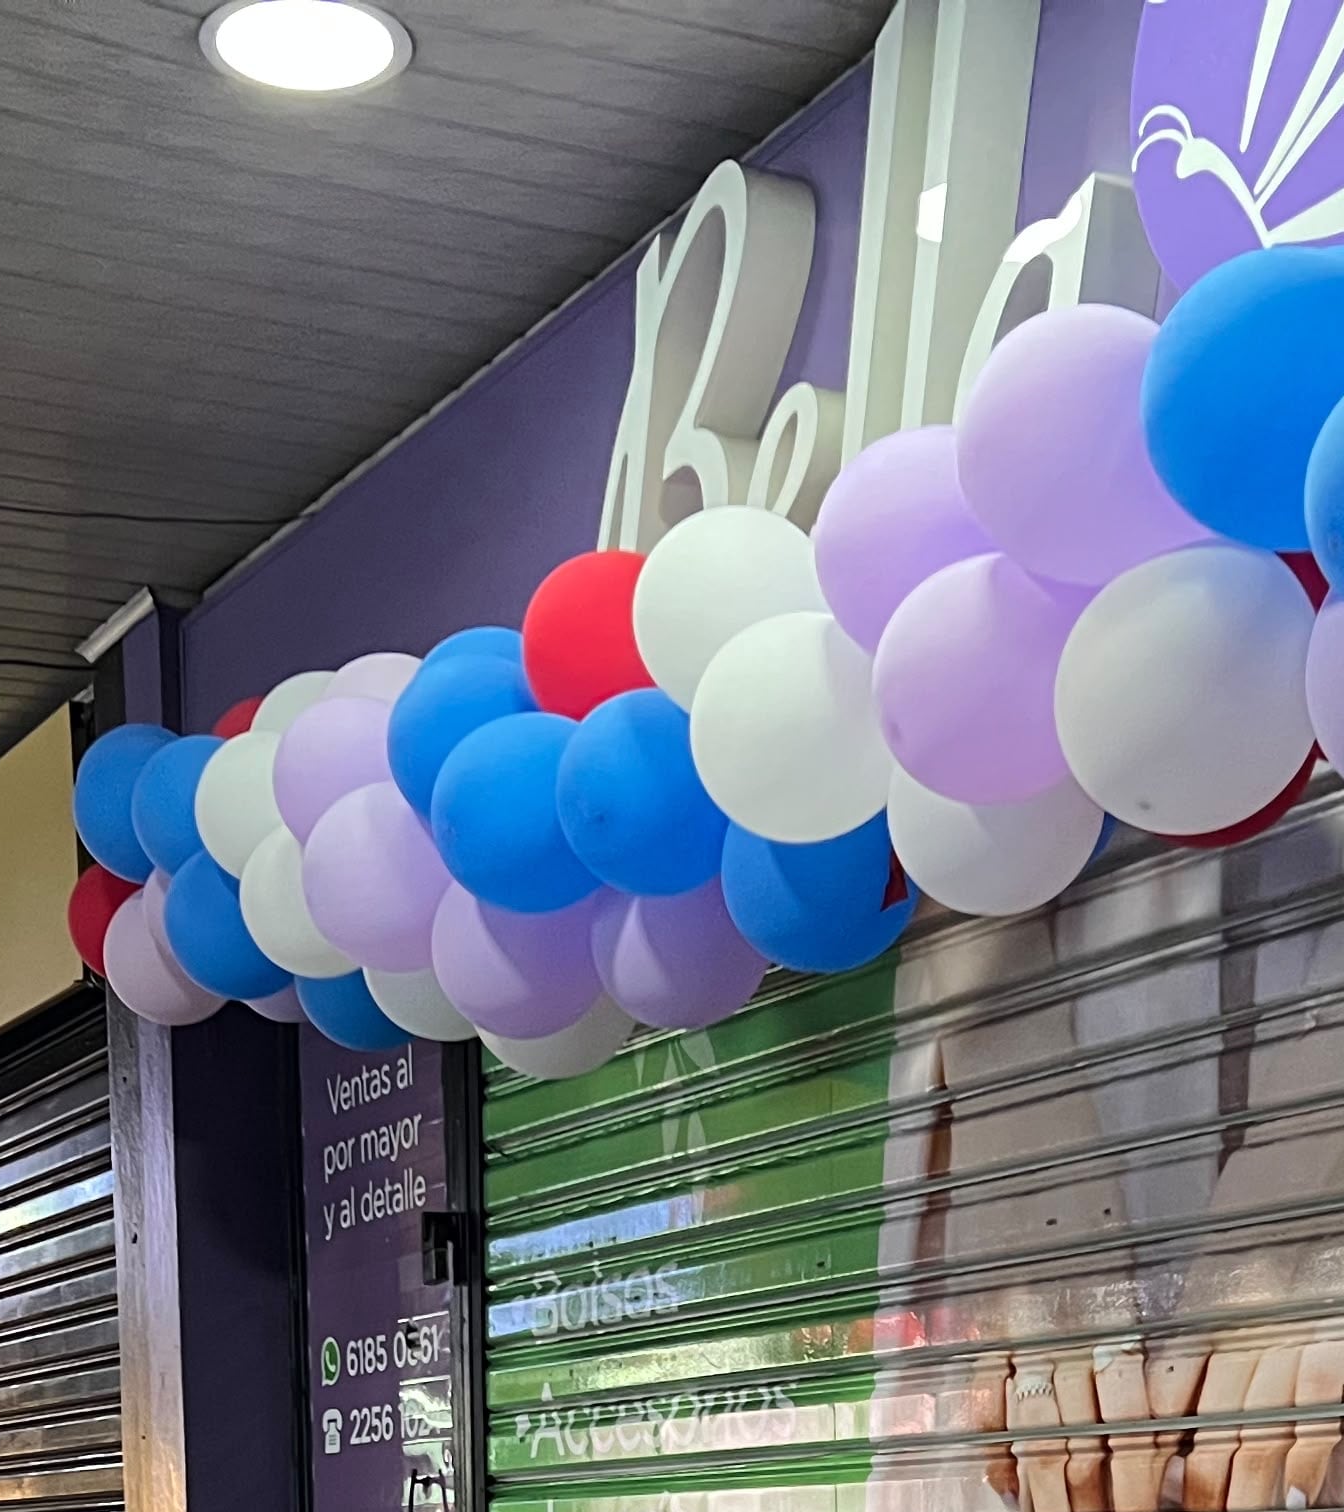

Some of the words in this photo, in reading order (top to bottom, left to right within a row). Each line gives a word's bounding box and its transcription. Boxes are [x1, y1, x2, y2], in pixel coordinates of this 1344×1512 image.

[327, 1062, 391, 1115] Ventas
[396, 1043, 413, 1090] al
[323, 1137, 355, 1184] por
[360, 1113, 422, 1164] mayor
[323, 1202, 335, 1241] y
[340, 1186, 356, 1229] al
[360, 1167, 426, 1223] detalle
[530, 1262, 680, 1338] Bolsas
[346, 1334, 388, 1377] 6185
[349, 1403, 394, 1445] 2256
[530, 1382, 798, 1459] Accesorios
